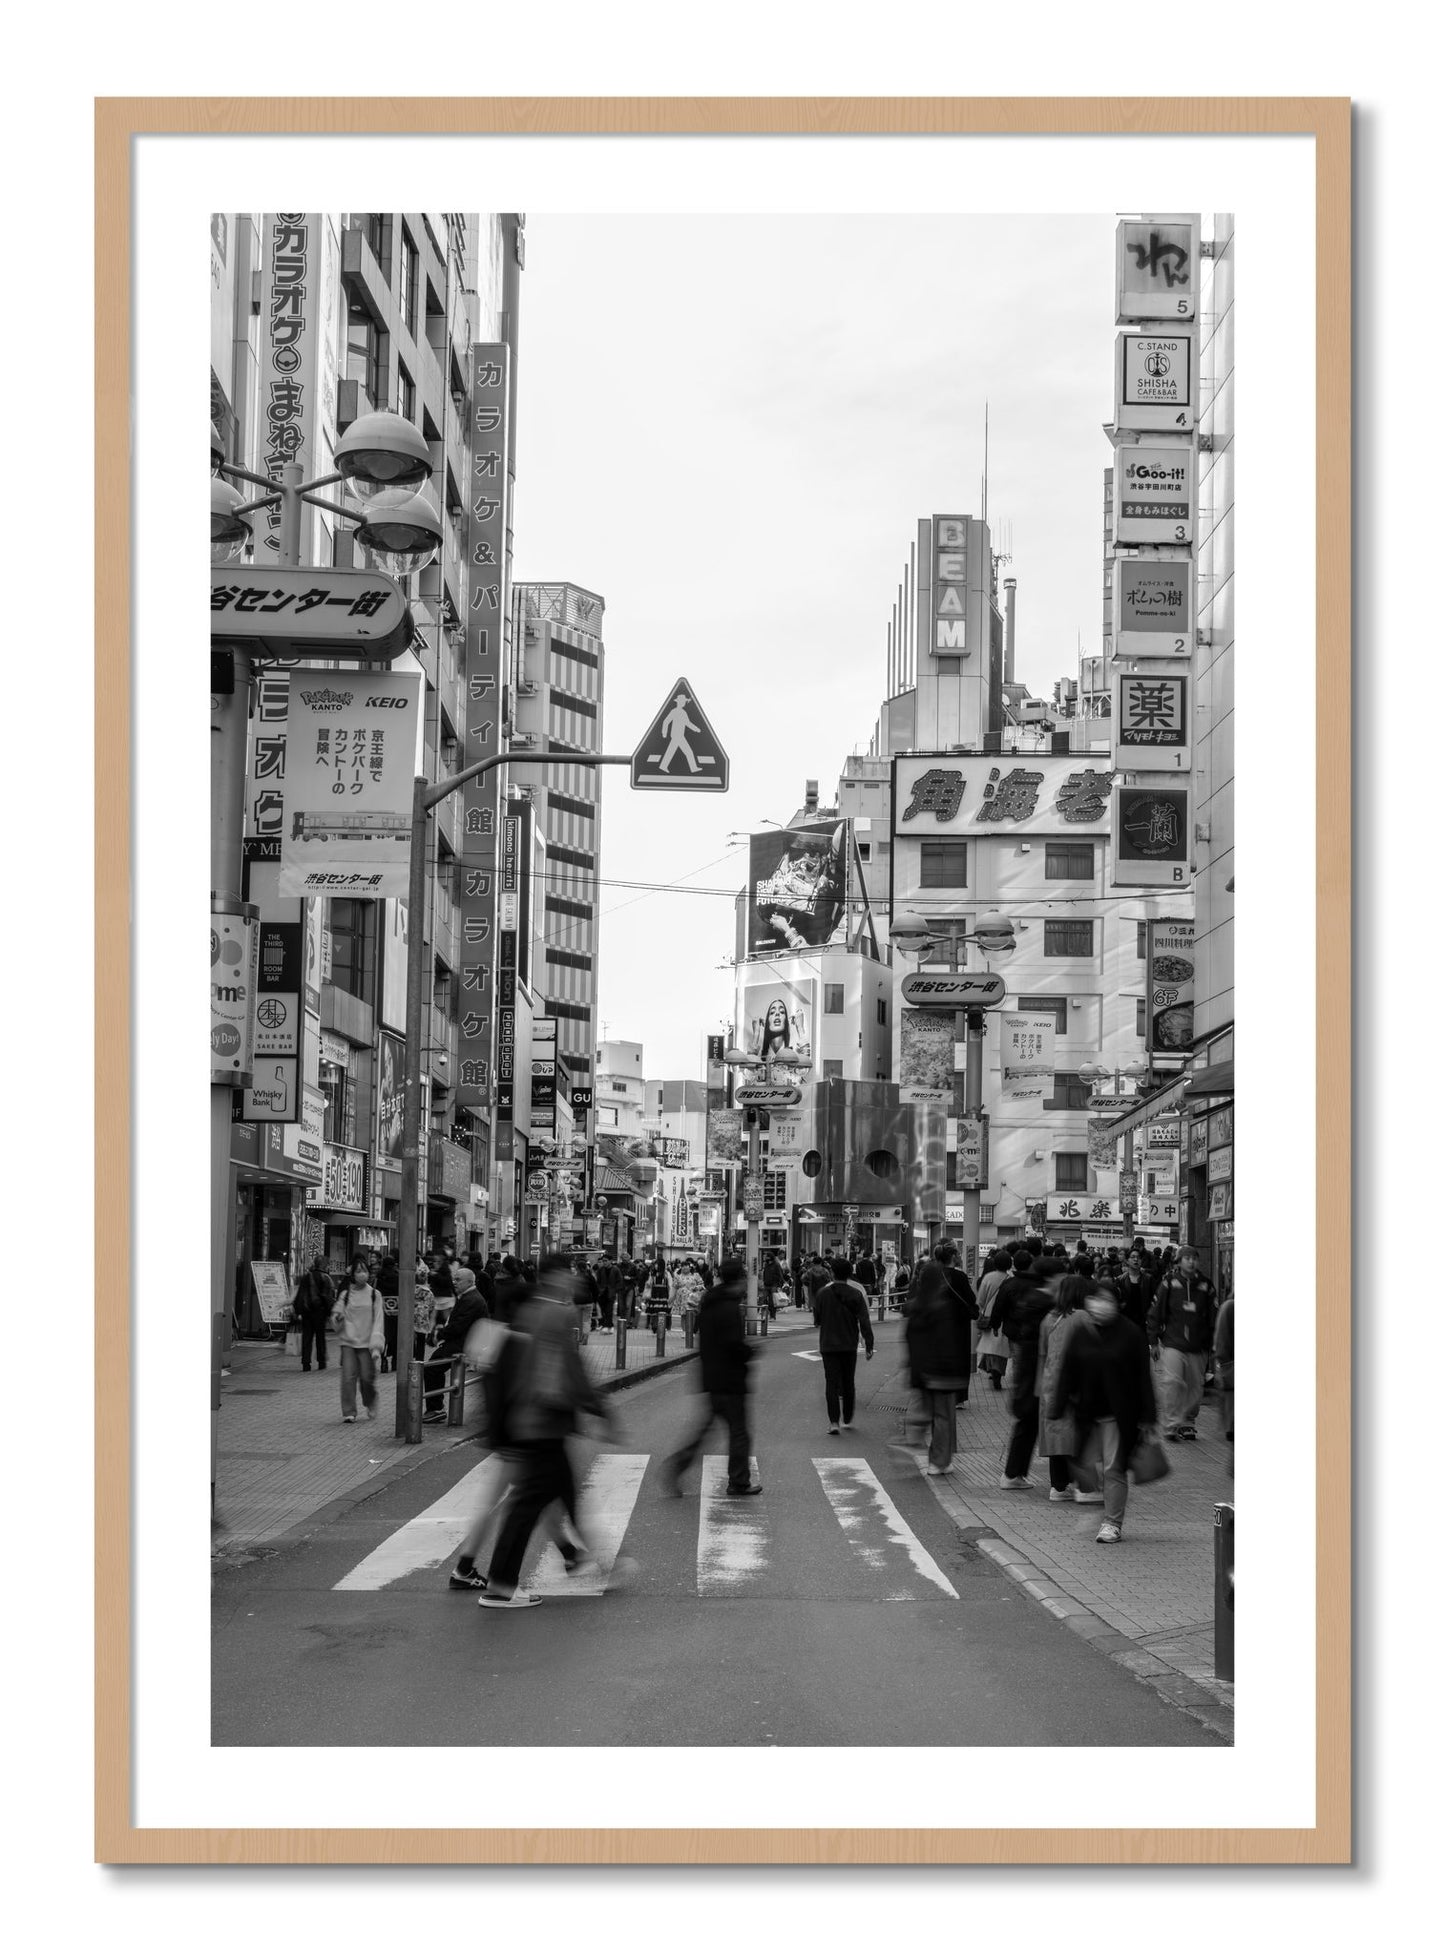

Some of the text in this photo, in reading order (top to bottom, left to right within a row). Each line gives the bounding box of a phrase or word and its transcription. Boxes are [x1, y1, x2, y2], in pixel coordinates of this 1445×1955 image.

[271, 224, 306, 345] カラオケ
[1177, 300, 1188, 314] 5
[1137, 342, 1178, 351] C.STAND
[1137, 378, 1177, 388] SHISHA
[1137, 388, 1177, 396] CAFE&BAR
[1125, 505, 1186, 516] 全身もみほぐし
[1175, 525, 1186, 540] 3
[937, 519, 967, 648] BEAM
[1174, 638, 1185, 653] 2
[365, 696, 409, 709] KEIO
[1129, 682, 1175, 728] 薬
[1124, 730, 1180, 743] マツモトキヨシ
[316, 728, 331, 767] 冒険へ
[332, 728, 349, 795] カントーの
[370, 729, 385, 783] 京王線で
[1174, 753, 1182, 768] 1
[902, 768, 1115, 823] 角海老
[304, 873, 384, 885] 渋谷センター街
[1173, 867, 1184, 881] B
[263, 965, 283, 973] ROOM
[908, 981, 999, 993] 渋谷センター街
[253, 1089, 283, 1099] Whisky
[573, 1093, 591, 1103] GU
[252, 1098, 271, 1106] Bank
